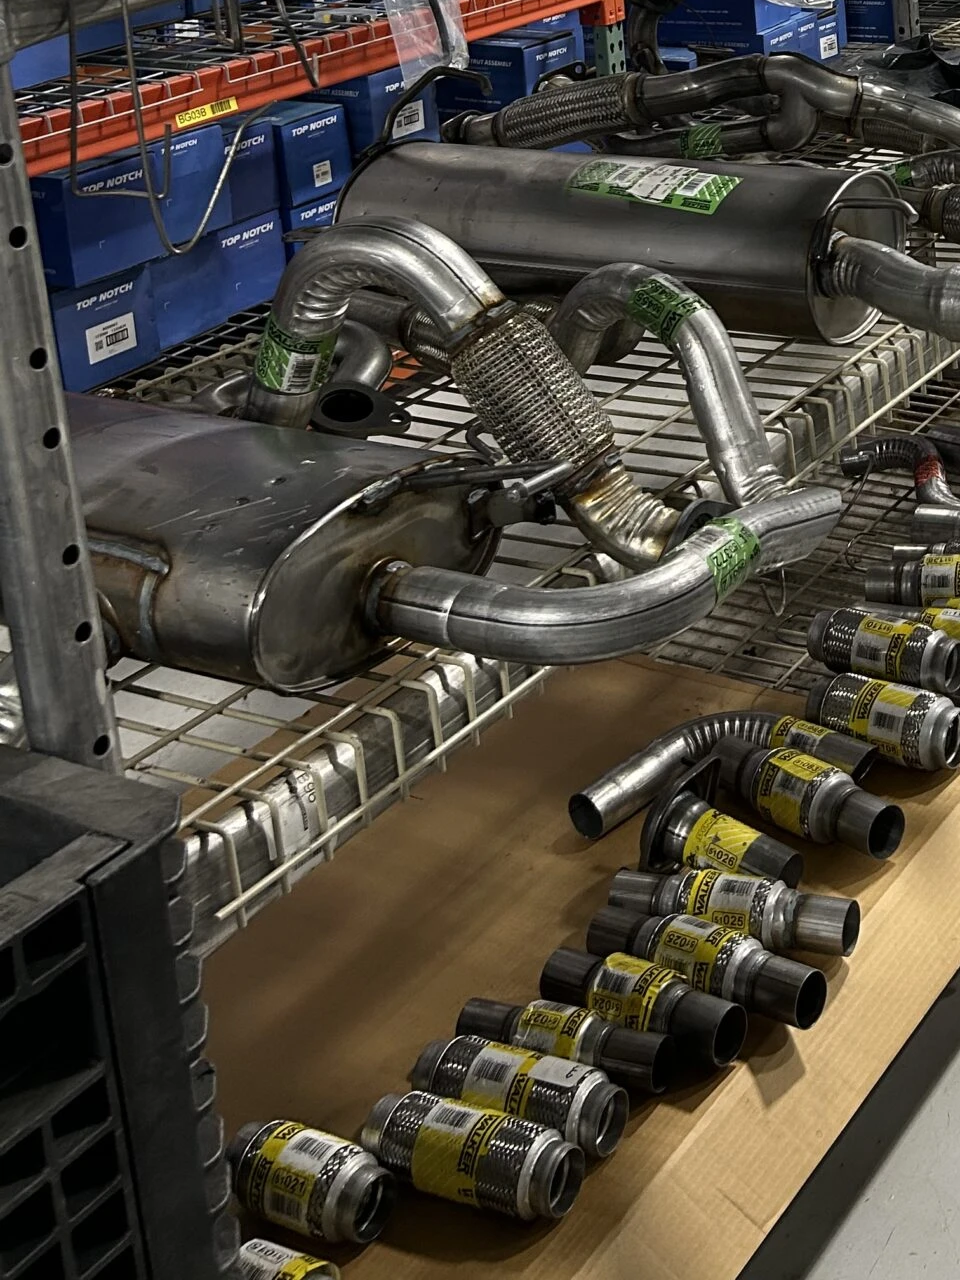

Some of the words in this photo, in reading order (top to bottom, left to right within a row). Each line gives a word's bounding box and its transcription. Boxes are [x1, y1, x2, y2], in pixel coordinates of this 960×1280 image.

[469, 59, 485, 67] TRUT
[384, 82, 400, 93] TOP
[178, 107, 207, 125] BG03B
[291, 126, 310, 137] TOP
[309, 115, 337, 133] NOTCH
[175, 138, 198, 151] NOTCH
[105, 169, 143, 190] NOTCH
[300, 209, 317, 221] TOP
[221, 235, 242, 249] TOP
[242, 221, 274, 242] NOTCH
[76, 296, 98, 311] TOP
[98, 281, 134, 302] NOTCH
[268, 325, 318, 353] WALKER
[857, 681, 887, 720] WALKER
[707, 846, 737, 867] 51026
[694, 870, 720, 916] WALKER
[713, 913, 745, 928] 51025
[666, 932, 697, 949] 51025
[458, 1113, 498, 1176] WALKER
[273, 1171, 307, 1196] 51021
